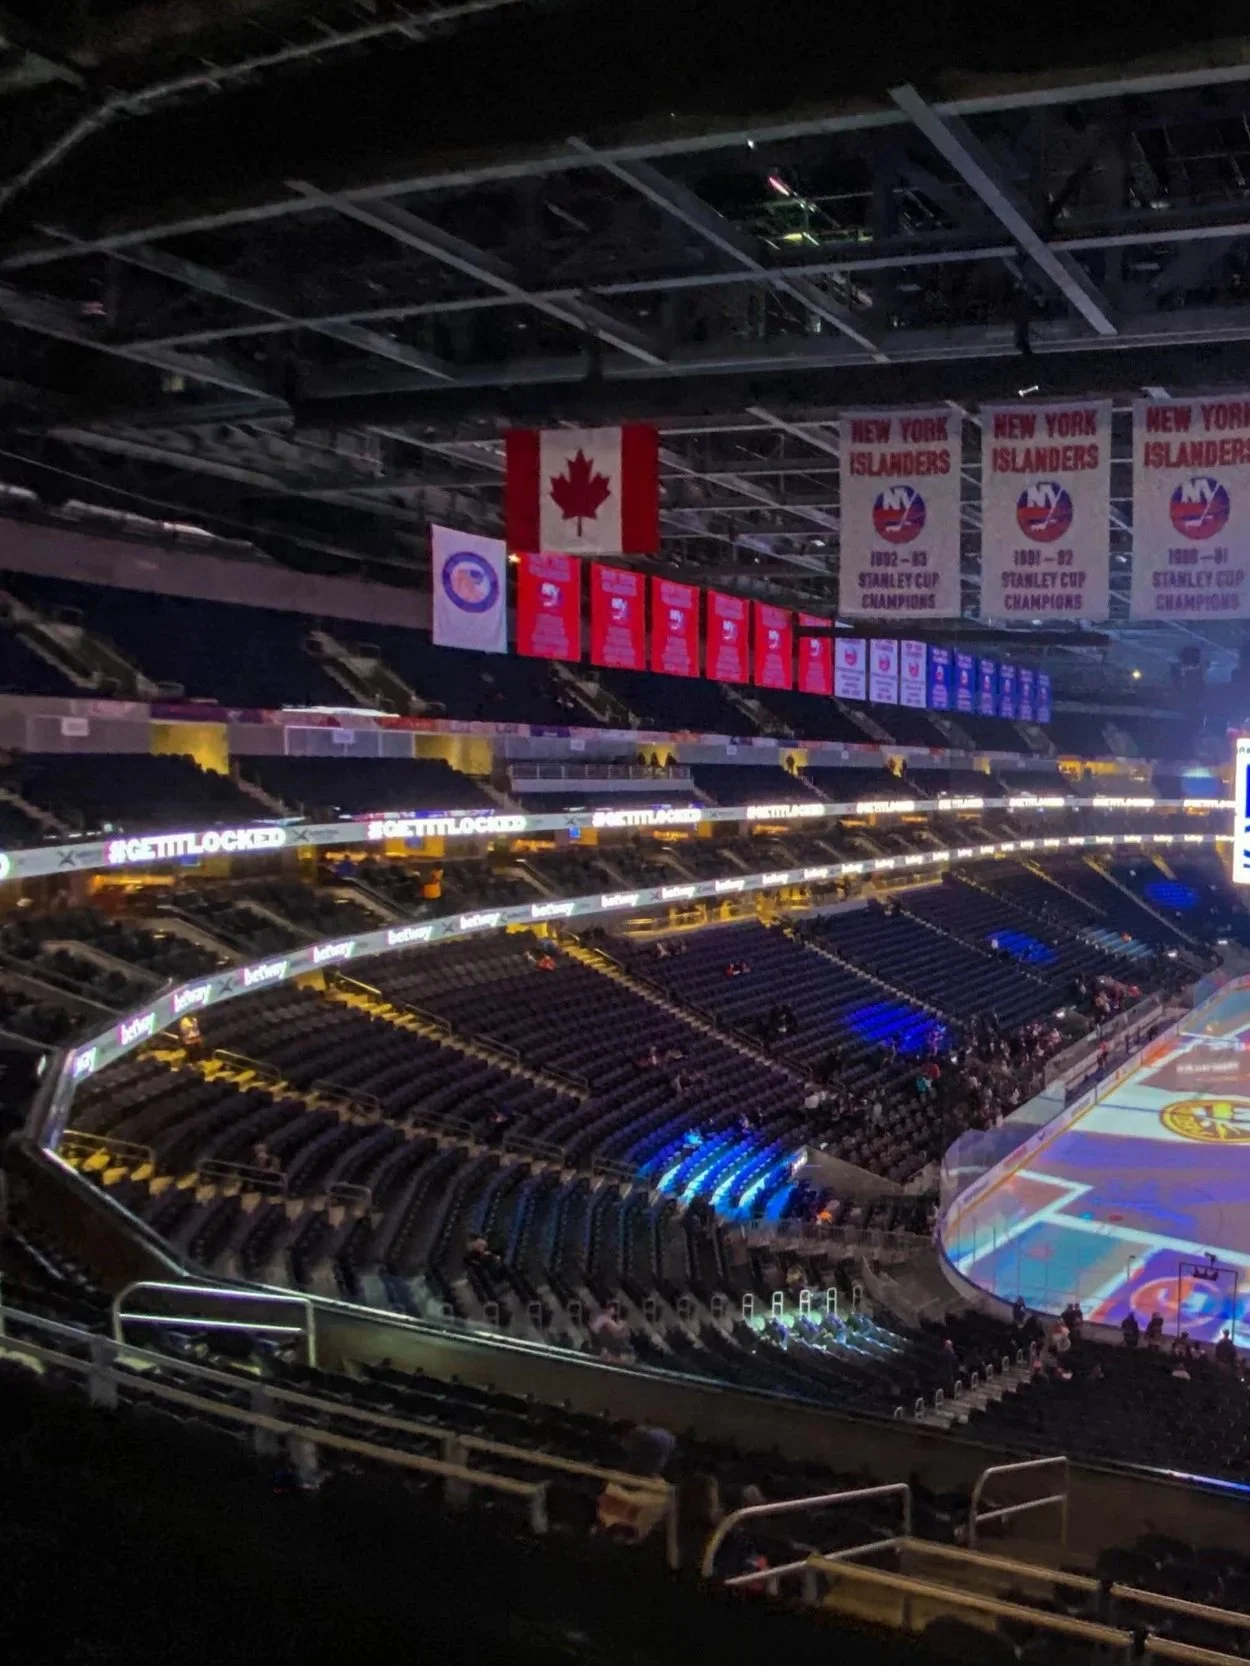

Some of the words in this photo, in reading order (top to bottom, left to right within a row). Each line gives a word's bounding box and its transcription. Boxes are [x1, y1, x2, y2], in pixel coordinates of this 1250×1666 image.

[852, 419, 891, 443] NEW
[901, 415, 948, 442] YORK
[994, 413, 1036, 439] NEW
[1045, 409, 1097, 437] YORK
[1145, 405, 1192, 432] NEW
[849, 448, 951, 477] ISLANDERS
[992, 444, 1099, 473] ISLANDERS
[858, 573, 913, 588] STANLEY
[915, 573, 939, 588] CUP
[1002, 572, 1058, 588] STANLEY
[1060, 572, 1086, 588] CUP
[1153, 572, 1213, 588] STANLEY
[1216, 570, 1244, 588] CUP
[861, 594, 935, 610] CHAMPIONS
[1005, 594, 1082, 610] CHAMPIONS
[1156, 594, 1239, 611] CHAMPIONS
[108, 827, 287, 864] #GETITLOCKED
[531, 902, 576, 919] betway
[387, 925, 434, 946] betway
[312, 941, 355, 964] betway
[243, 960, 288, 987] betway
[173, 984, 212, 1013] betway
